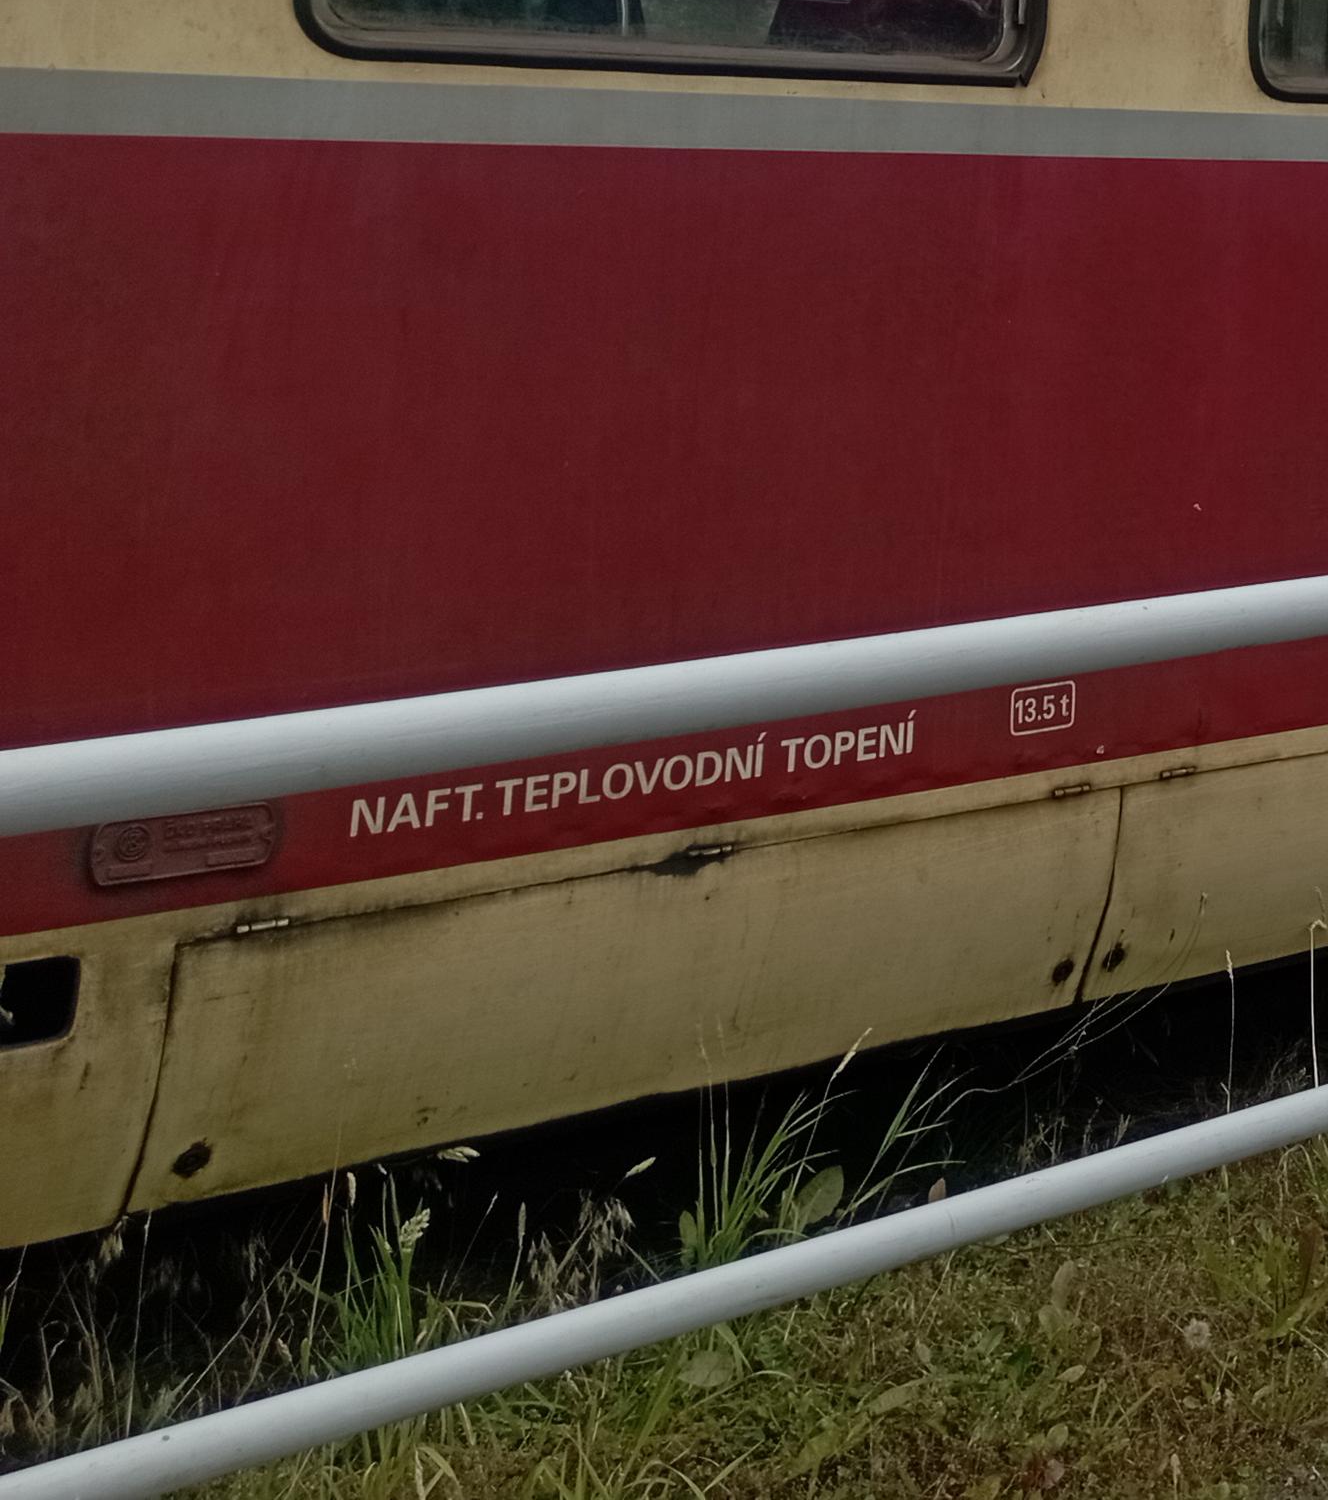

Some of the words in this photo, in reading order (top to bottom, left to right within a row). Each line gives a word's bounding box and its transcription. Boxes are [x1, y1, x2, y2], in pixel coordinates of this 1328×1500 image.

[349, 784, 484, 837] NAFT.
[495, 732, 768, 817] TEPLOVODNÍ
[780, 710, 917, 773] TOPENÍ
